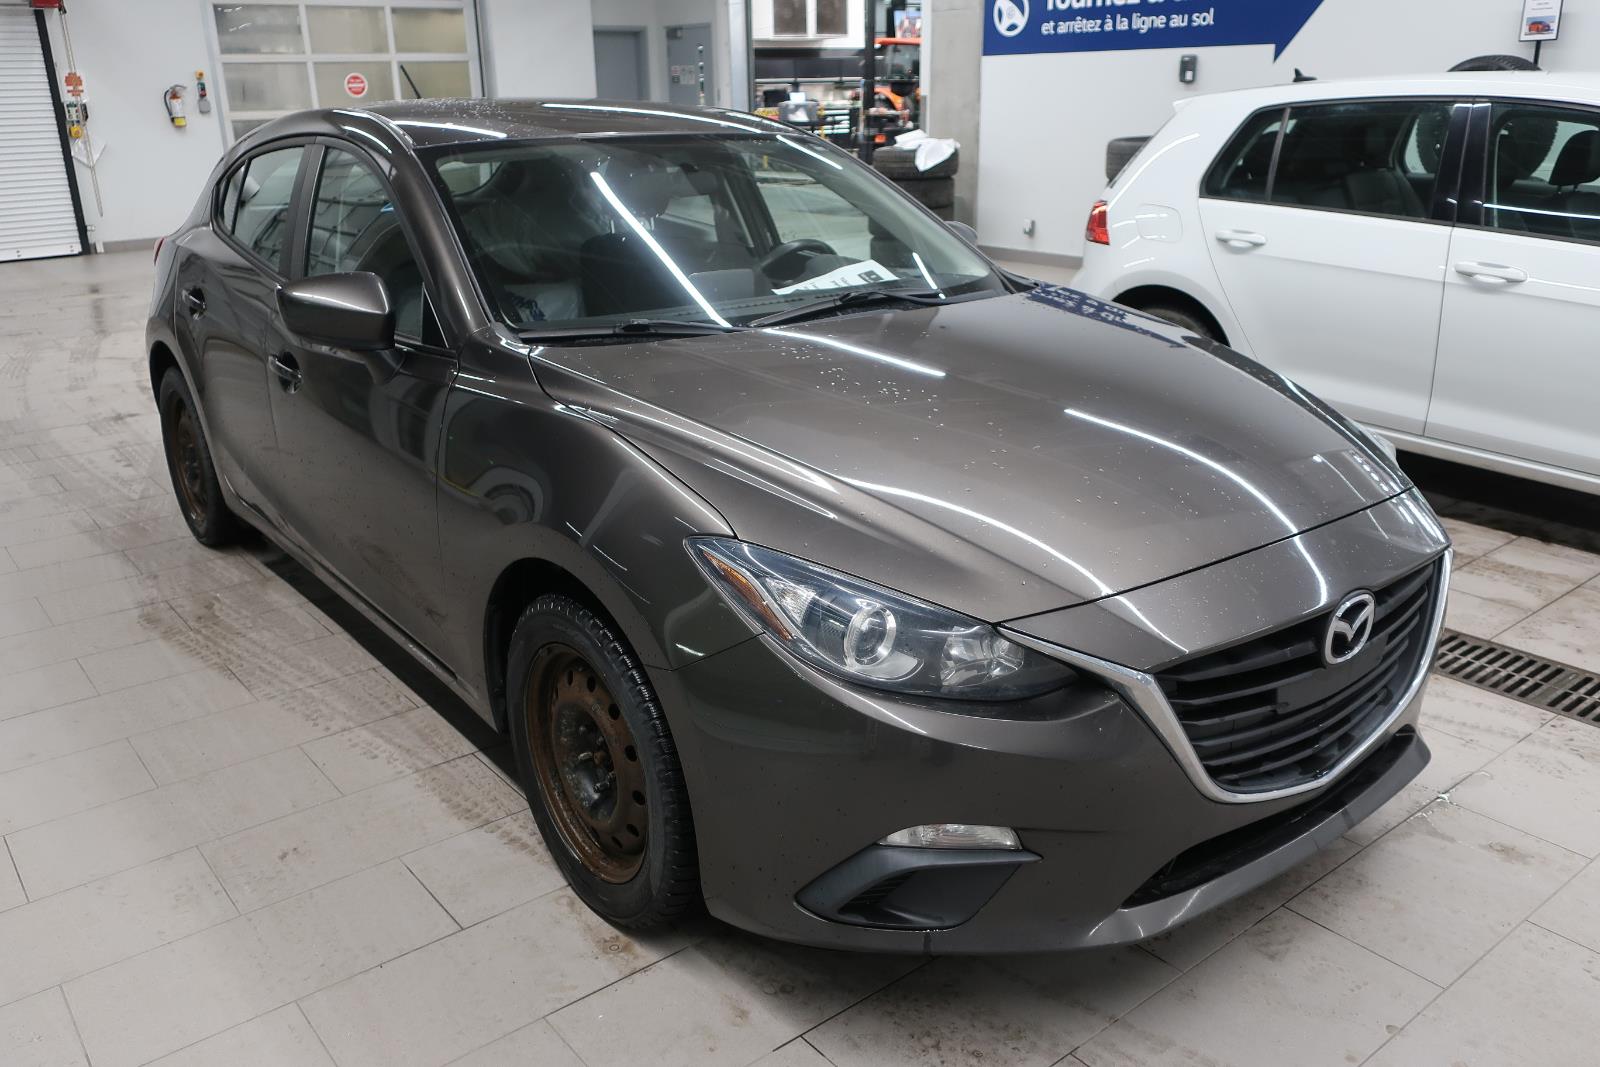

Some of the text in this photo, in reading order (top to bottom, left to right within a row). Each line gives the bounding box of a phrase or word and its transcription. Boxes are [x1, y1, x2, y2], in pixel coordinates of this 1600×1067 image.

[1041, 7, 1214, 35] et arrêtez à la ligne au sol
